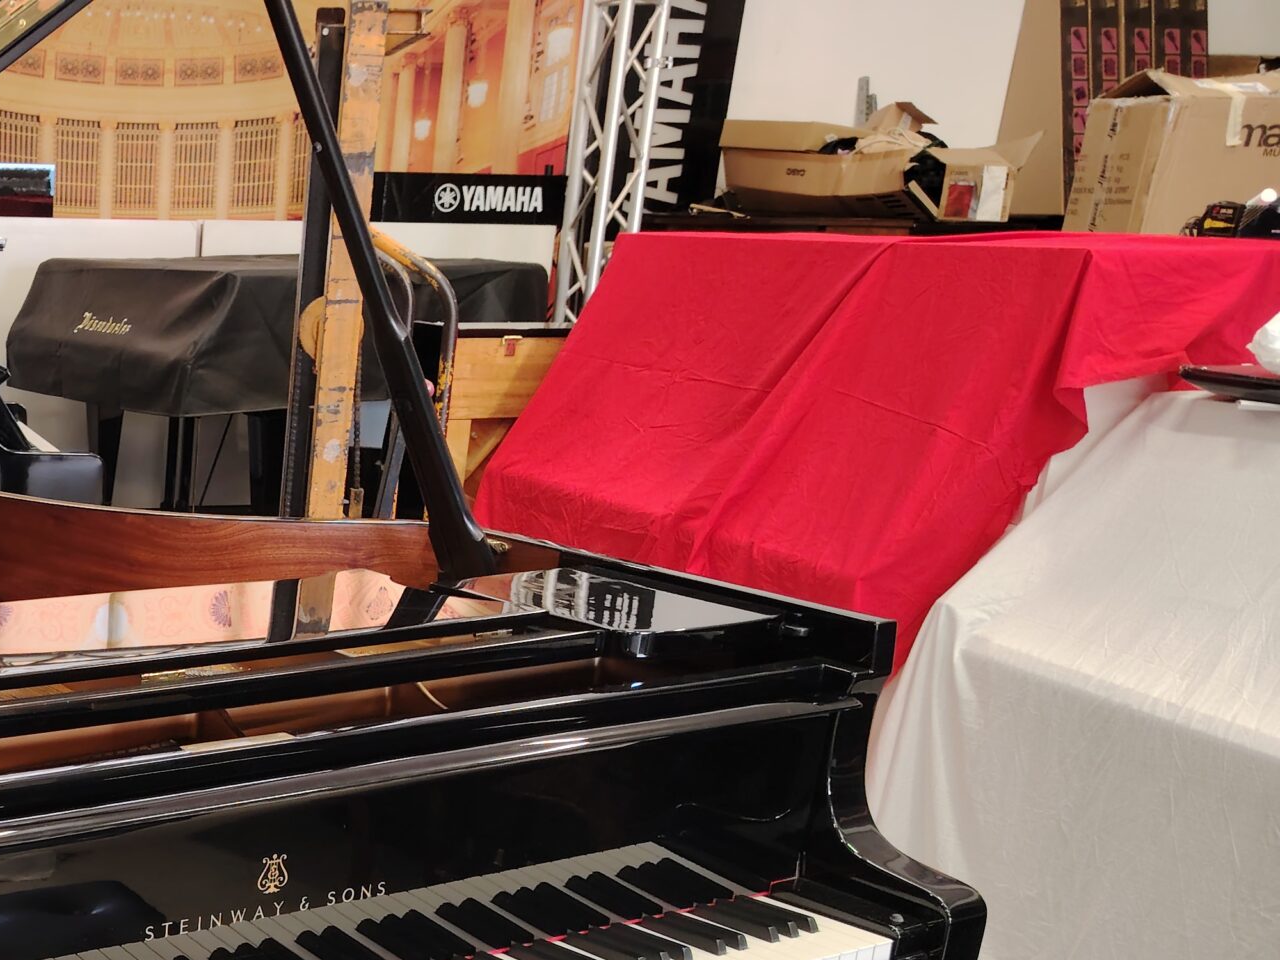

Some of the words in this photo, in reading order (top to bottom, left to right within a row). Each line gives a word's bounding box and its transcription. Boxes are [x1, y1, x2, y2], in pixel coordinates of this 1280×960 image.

[461, 185, 543, 213] YAMAHA
[144, 900, 284, 943] STEINWAY
[299, 896, 310, 911] &
[327, 881, 386, 906] SONS
